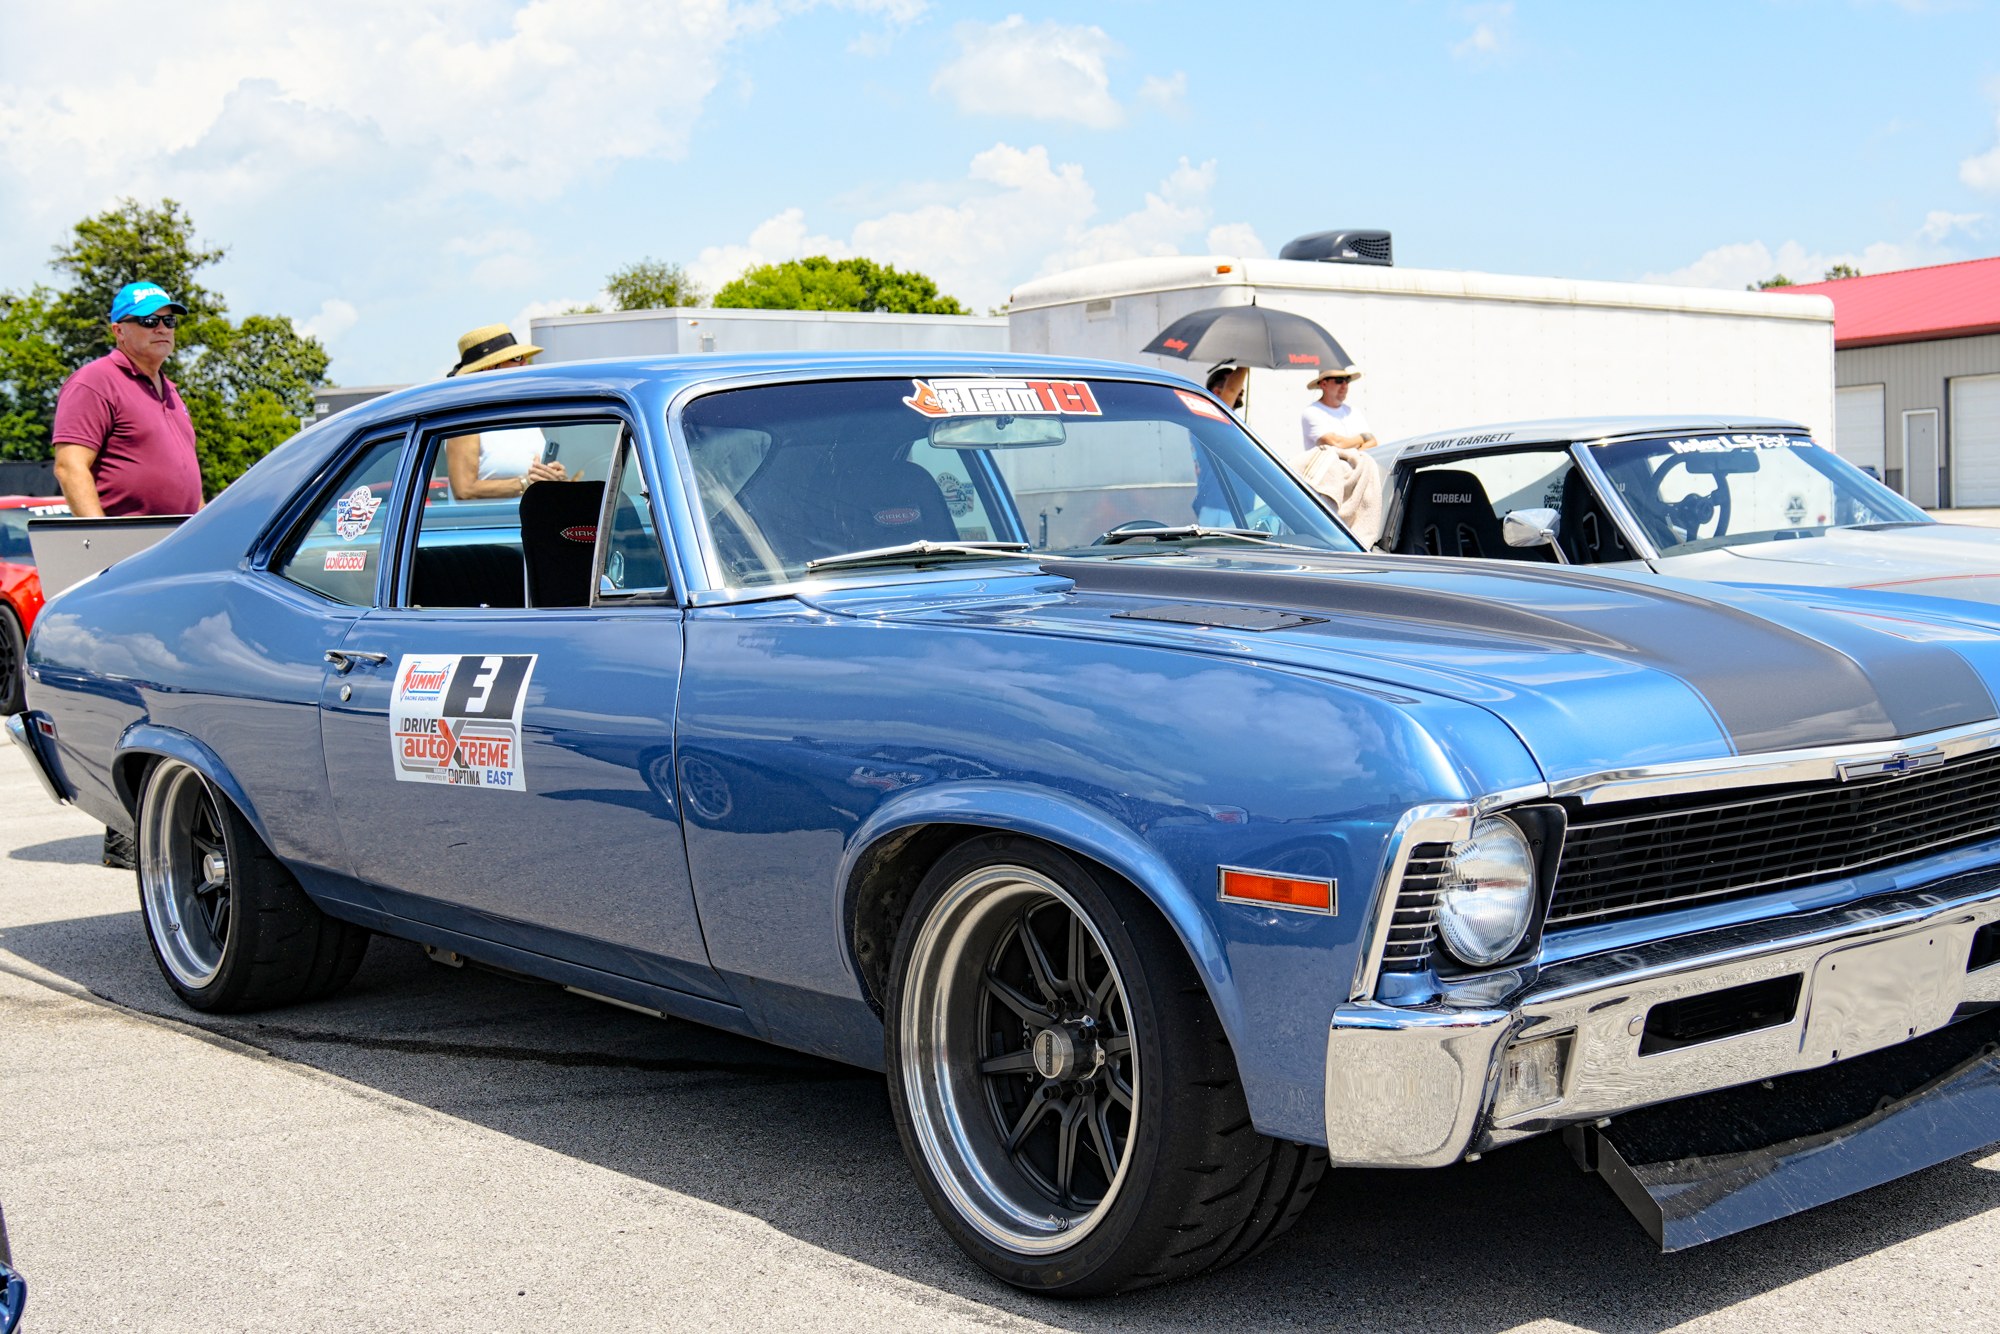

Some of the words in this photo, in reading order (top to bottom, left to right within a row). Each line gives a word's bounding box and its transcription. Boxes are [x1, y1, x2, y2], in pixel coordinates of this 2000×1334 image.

[1424, 438, 1457, 451] TONY
[1457, 432, 1515, 446] GARRETT
[1432, 493, 1472, 503] CORBEAU
[465, 656, 503, 713] 3
[404, 718, 437, 733] DRIVE
[454, 769, 480, 785] OPTIMA
[487, 770, 513, 786] EAST
